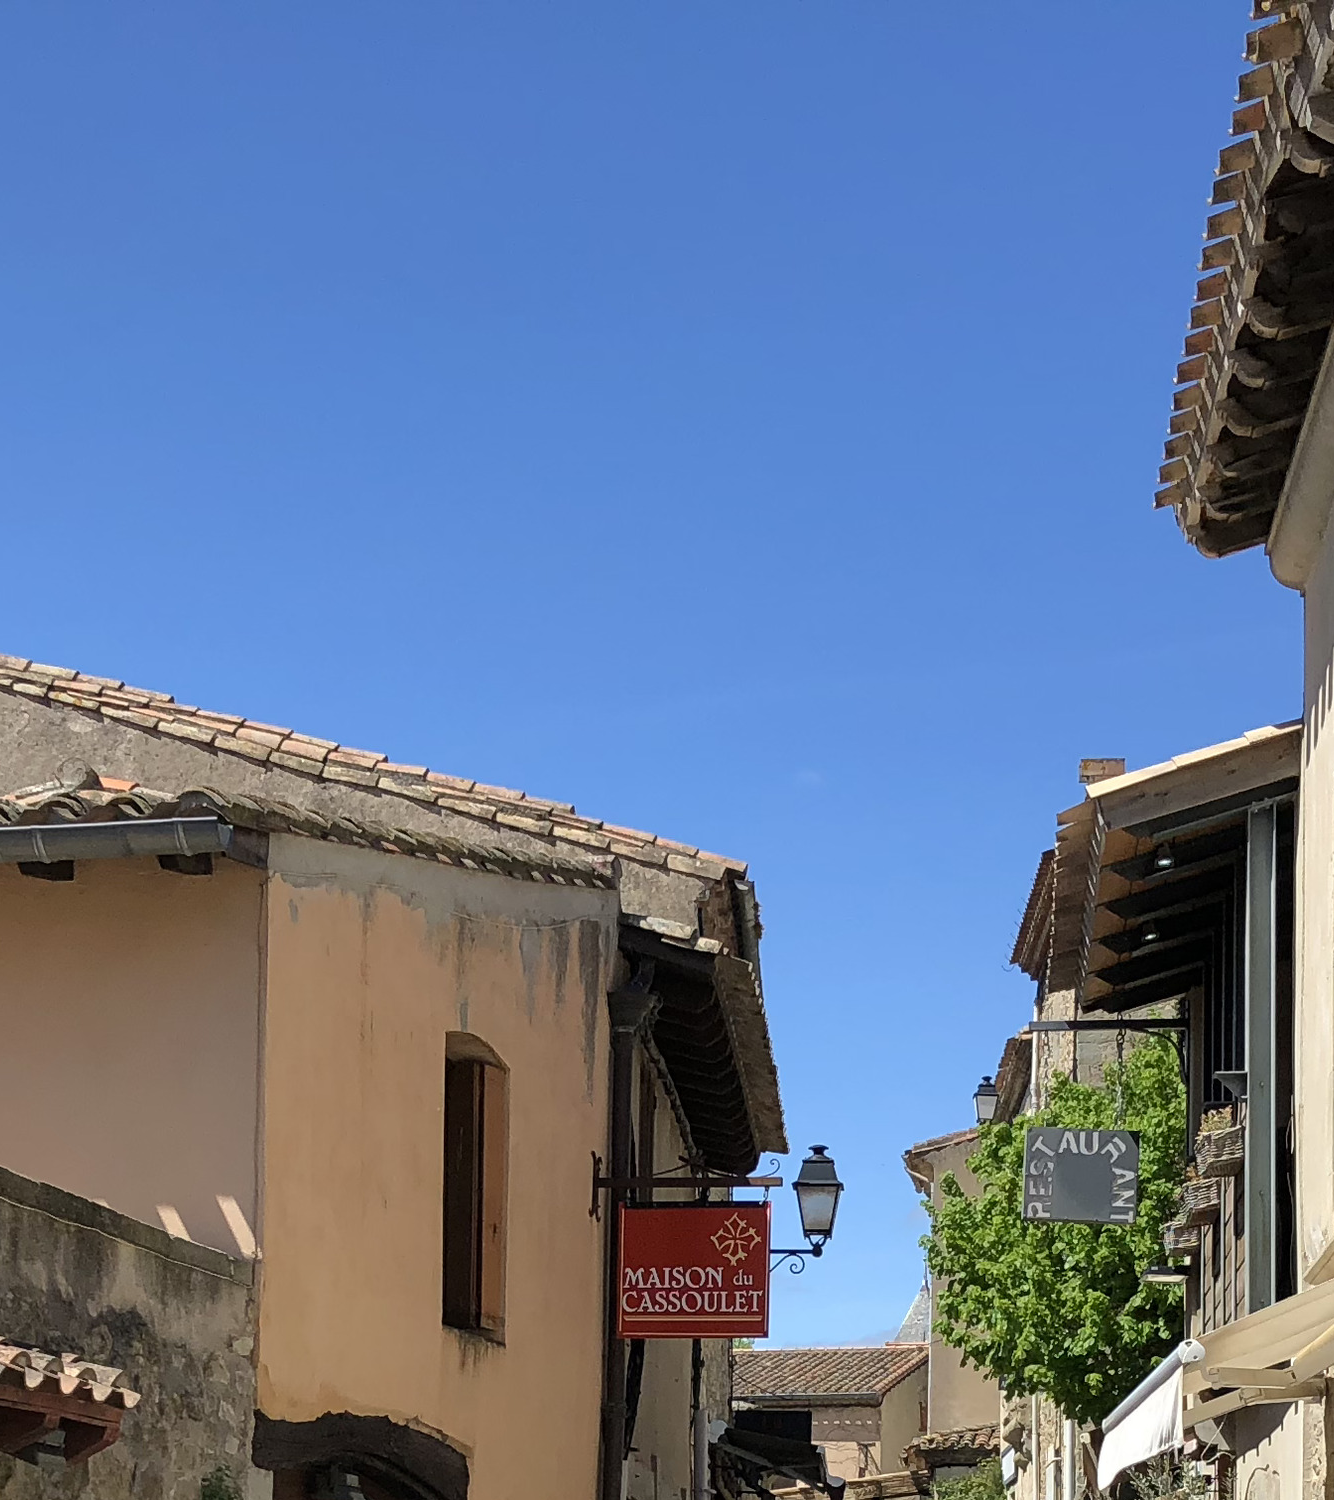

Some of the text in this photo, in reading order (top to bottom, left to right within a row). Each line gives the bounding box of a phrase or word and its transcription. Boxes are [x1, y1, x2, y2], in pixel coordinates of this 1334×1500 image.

[1026, 1130, 1136, 1223] RESTAURANT
[623, 1266, 754, 1289] MAISON du
[621, 1289, 763, 1313] CASSOULET
